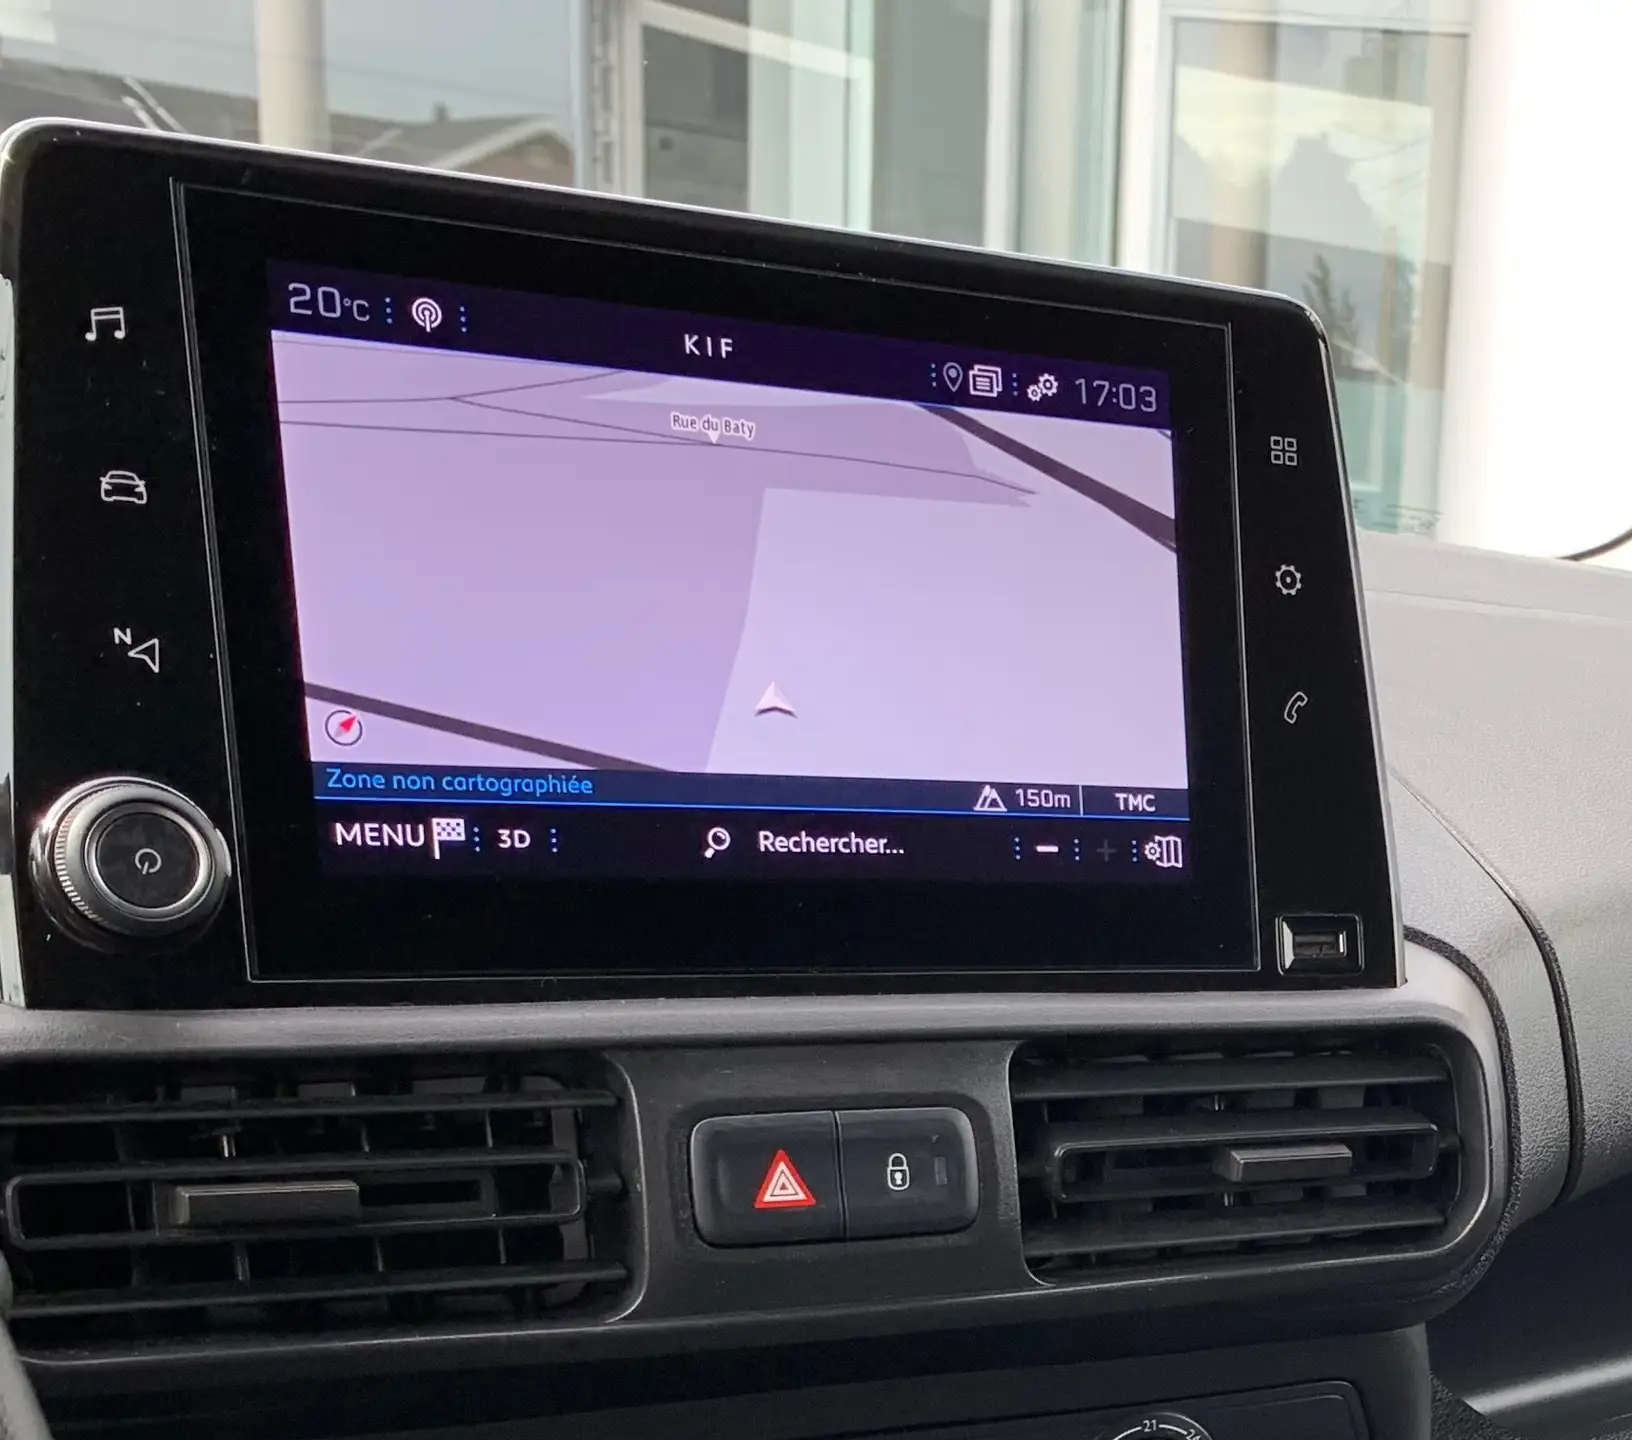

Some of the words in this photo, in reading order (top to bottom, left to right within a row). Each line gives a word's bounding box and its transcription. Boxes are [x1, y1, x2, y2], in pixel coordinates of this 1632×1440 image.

[1073, 376, 1158, 413] 17:03
[672, 414, 697, 429] Rue
[702, 416, 719, 431] du
[723, 419, 754, 439] Baty
[326, 768, 386, 790] Zone
[392, 775, 435, 791] non
[441, 773, 594, 797] cartographiée
[1015, 787, 1071, 808] 150m
[1115, 792, 1156, 812] TMC
[334, 821, 426, 848] MENU
[498, 828, 532, 848] 3D
[757, 829, 905, 856] Rechercher...
[1142, 1419, 1157, 1433] 21
